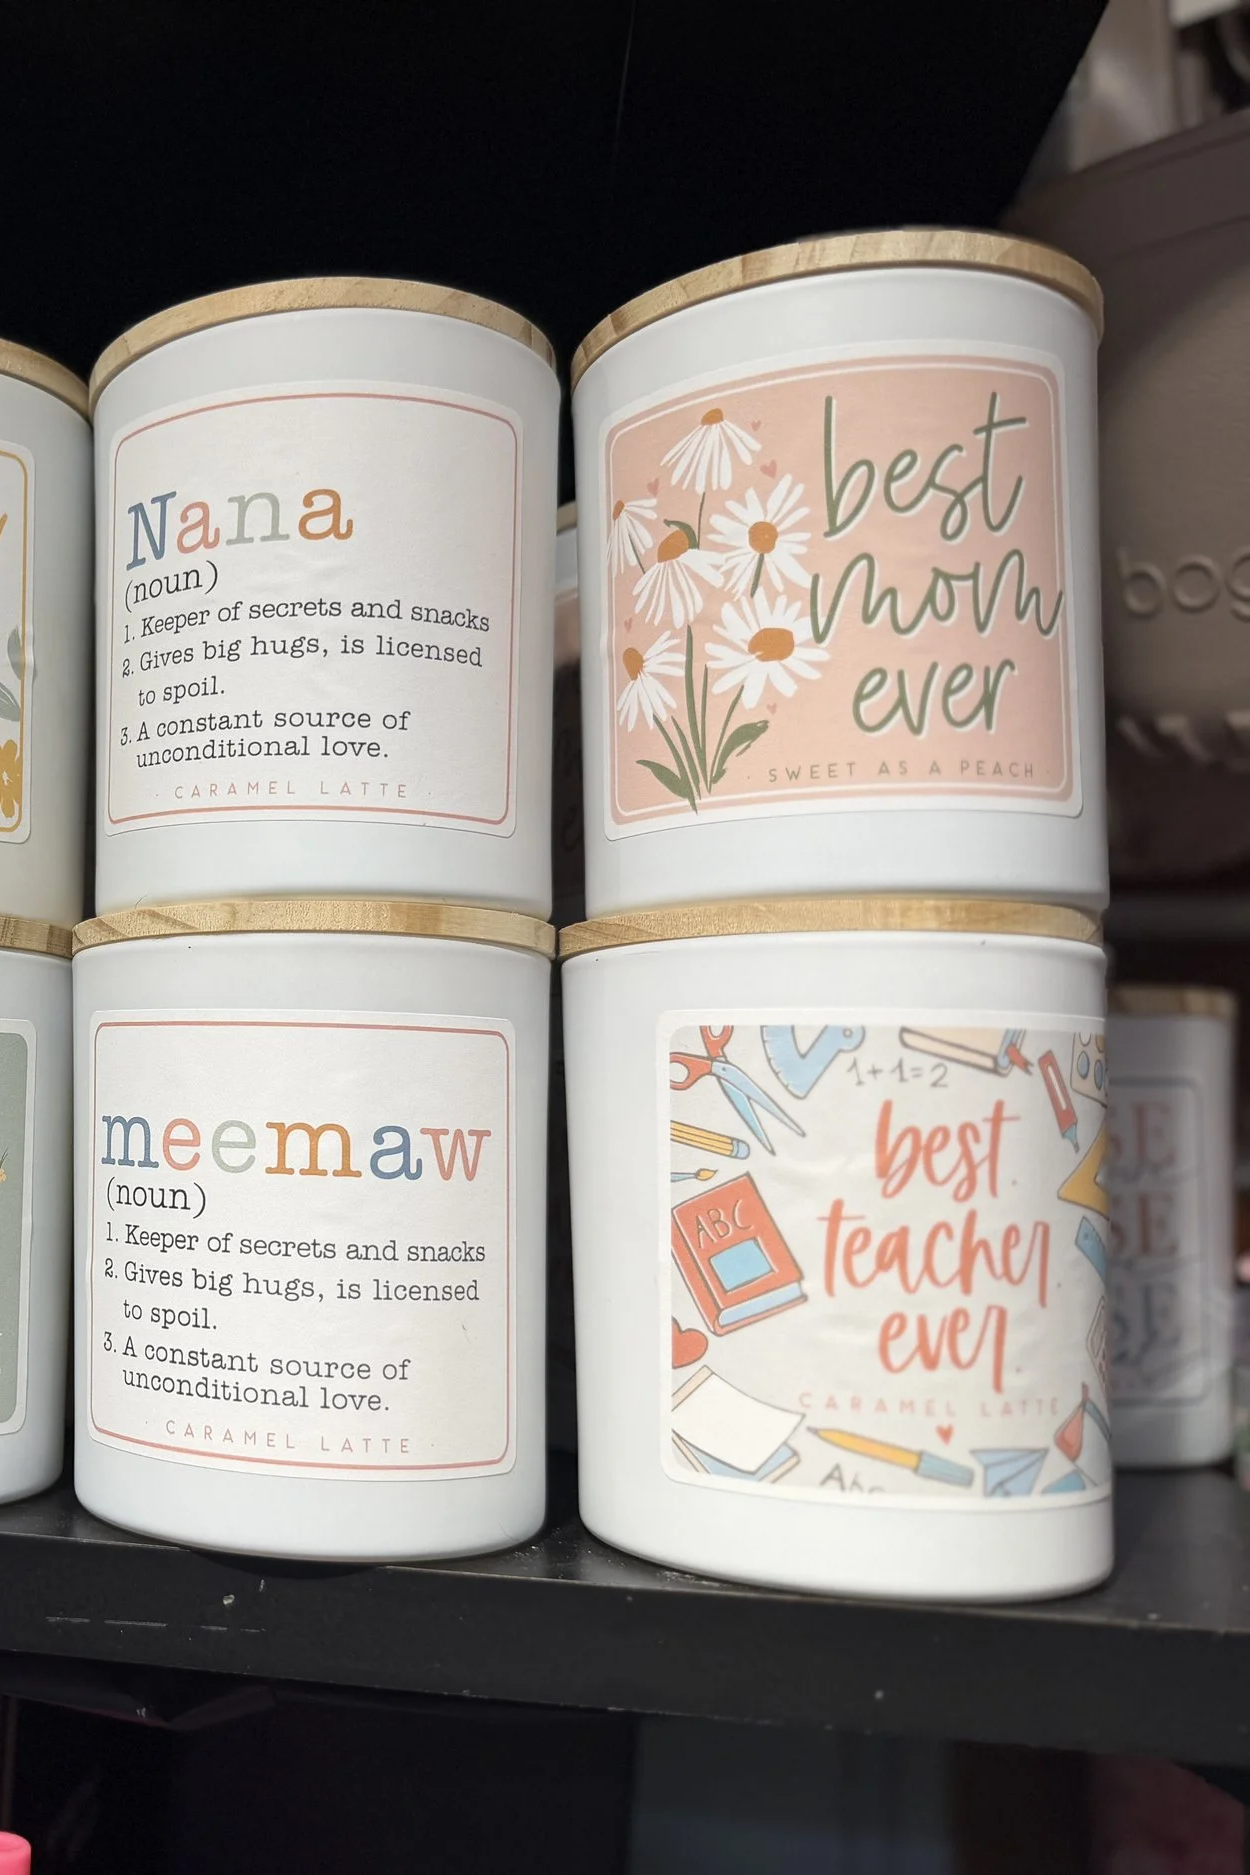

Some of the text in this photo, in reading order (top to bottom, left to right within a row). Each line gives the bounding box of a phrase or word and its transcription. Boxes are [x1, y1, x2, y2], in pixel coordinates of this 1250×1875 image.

[823, 391, 1028, 542] best
[126, 488, 354, 571] Nana
[124, 560, 219, 613] (noun)
[809, 548, 1064, 645] mom
[124, 598, 490, 644] 1. Keeper of secrets and snacks
[122, 634, 483, 678] 2. Gives big hugs, is licensed
[138, 675, 225, 707] to spoil.
[852, 658, 1016, 737] ever
[120, 709, 412, 746] 3. A constant source of
[137, 736, 389, 768] unconditional love.
[768, 760, 1034, 783] SWEET AS A PEACH
[175, 780, 407, 799] CARAMEL LATTE
[101, 1114, 492, 1182] meemaw
[875, 1099, 1021, 1202] best
[106, 1176, 207, 1219] (noun)
[106, 1222, 486, 1263] 1. Keeper of secrets and snacks
[694, 1199, 756, 1249] ABC
[817, 1198, 1050, 1308] teacher
[104, 1258, 480, 1303] 2. Gives big hugs, is licensed
[123, 1300, 217, 1331] to spoil.
[103, 1332, 411, 1381] 3. A constant source of
[878, 1305, 1008, 1395] ever
[122, 1366, 390, 1412] unconditional love.
[799, 1392, 1058, 1418] CARAMEL LATTE
[166, 1420, 410, 1454] CARAMEL LATTE
